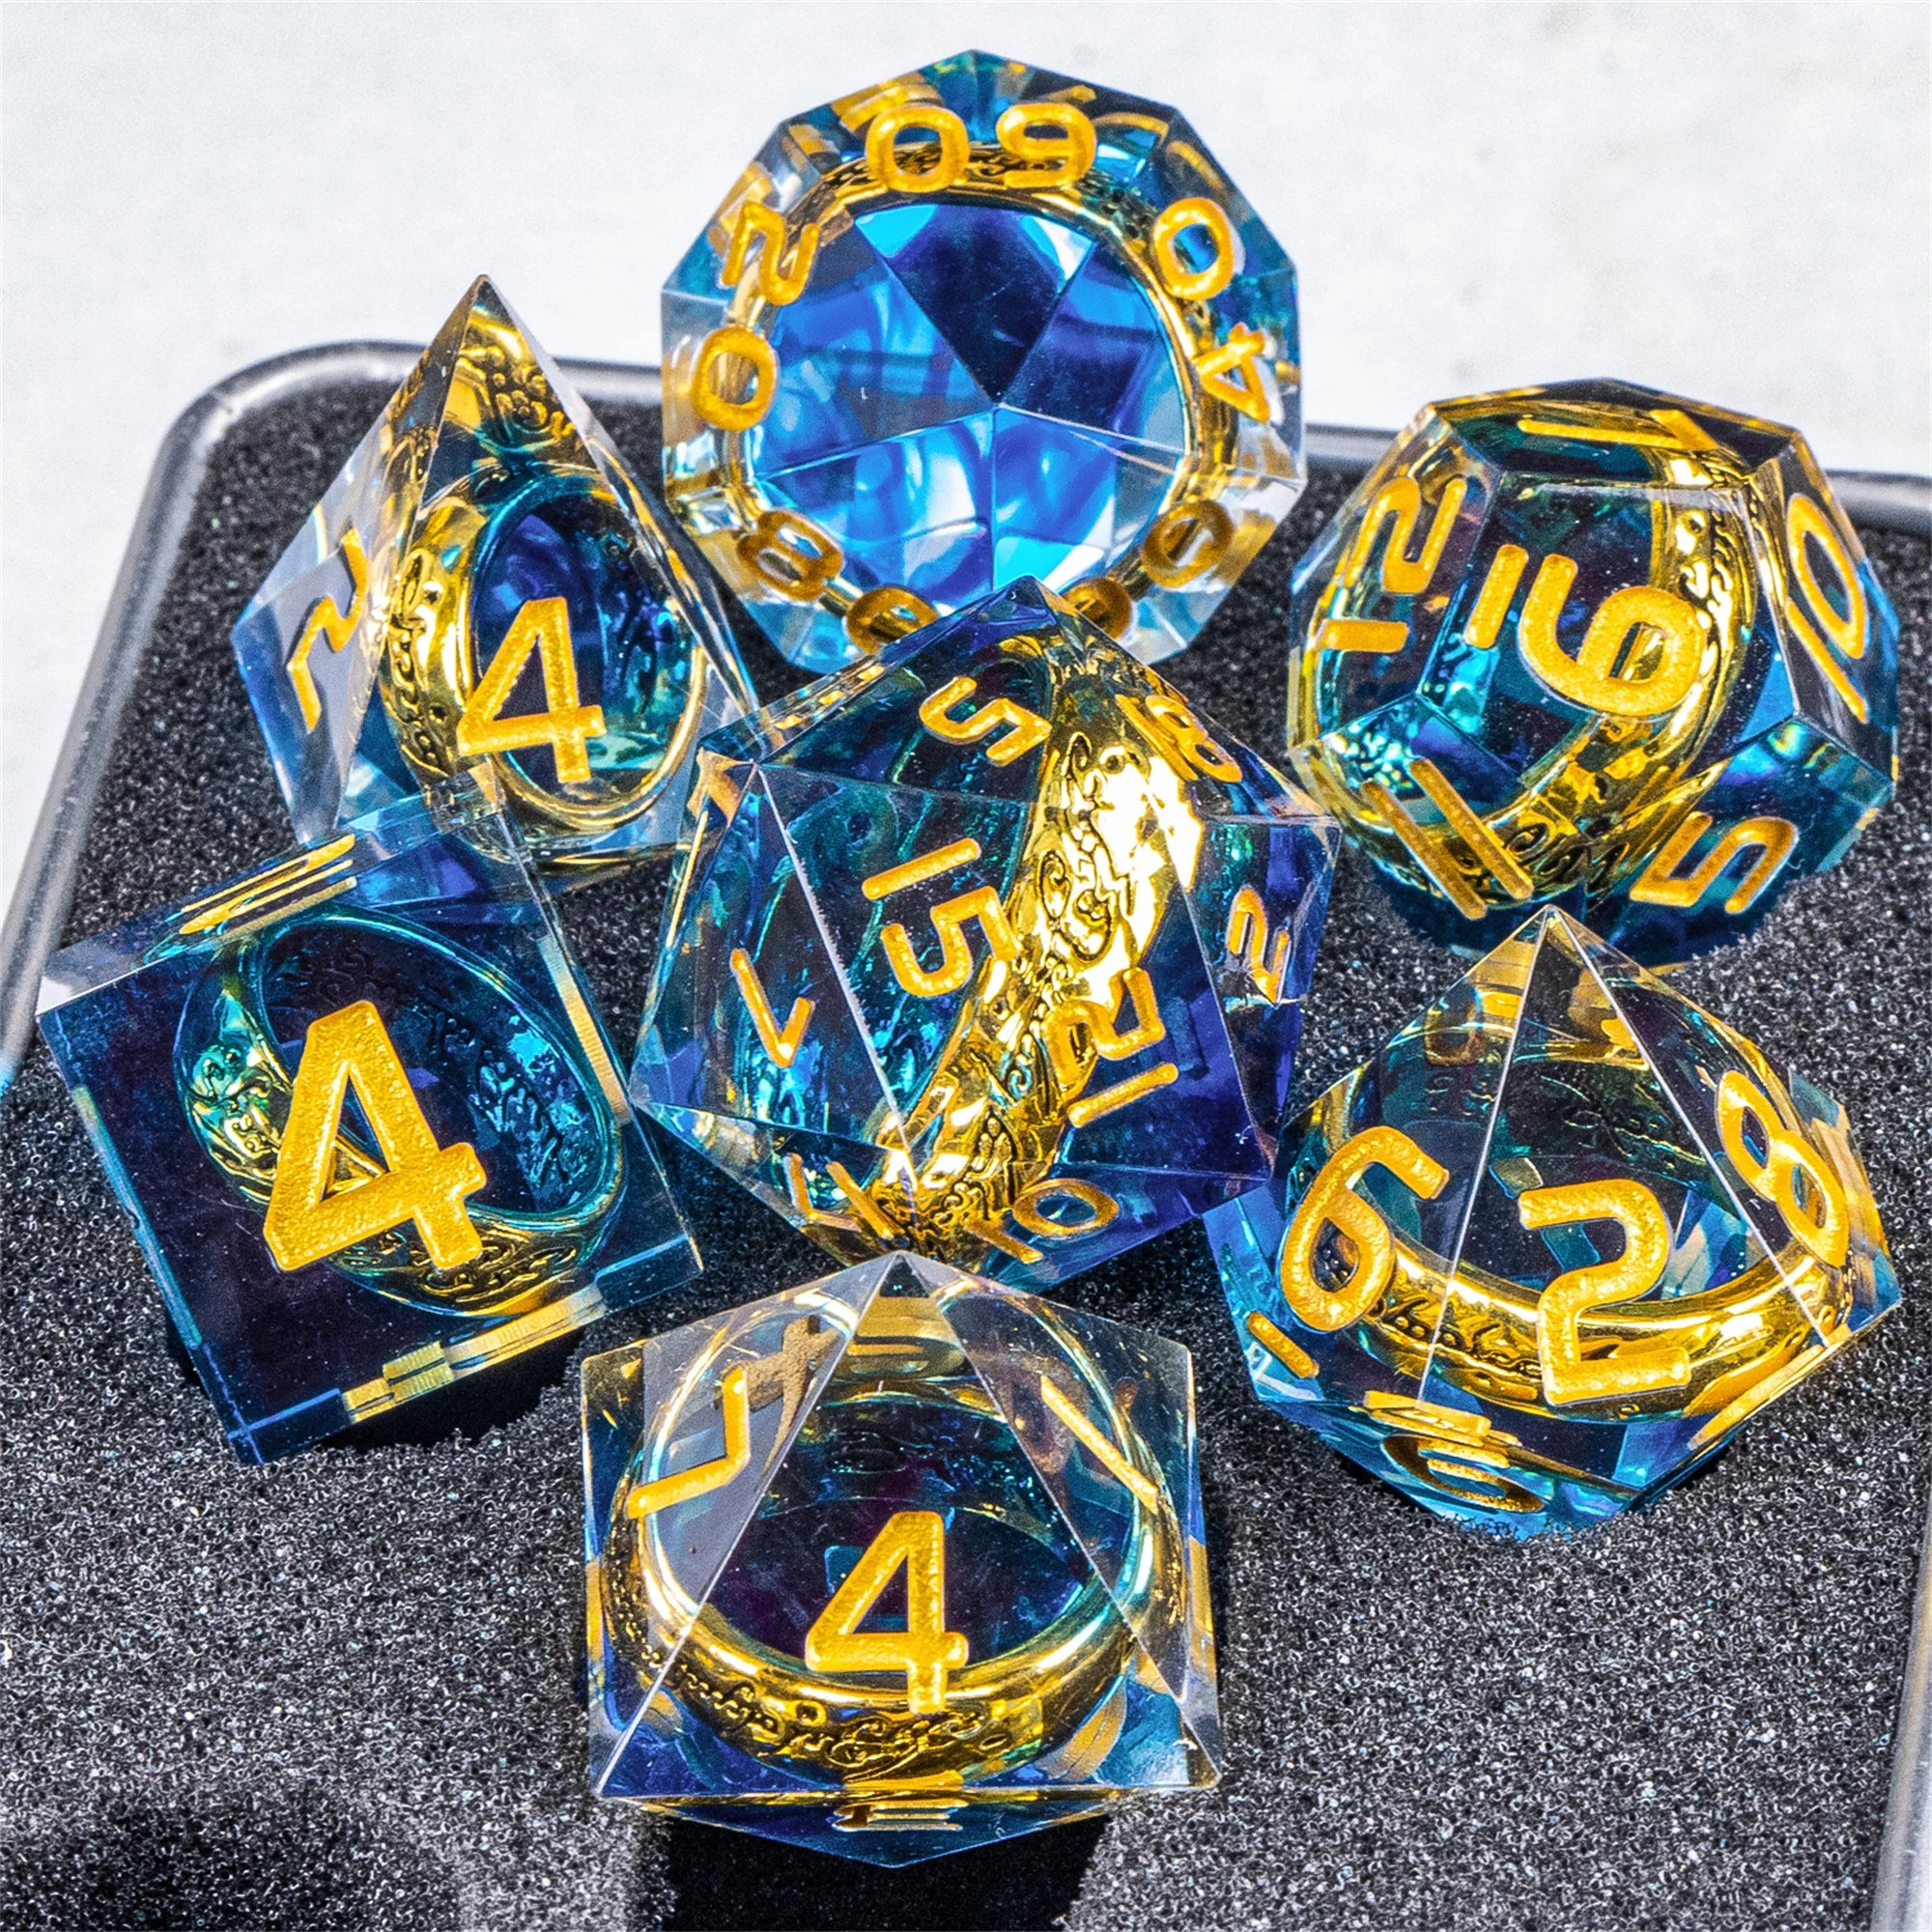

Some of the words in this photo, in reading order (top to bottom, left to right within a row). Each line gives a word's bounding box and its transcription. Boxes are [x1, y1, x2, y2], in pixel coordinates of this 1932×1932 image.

[1316, 476, 1468, 653] 12
[1785, 493, 1869, 724] 10
[456, 596, 608, 784] 4
[918, 676, 1052, 768] 5
[1113, 694, 1243, 784] 18
[862, 837, 1020, 999] 15
[1629, 810, 1800, 915] 5
[263, 999, 487, 1272] 4
[1039, 966, 1179, 1129] 12
[1715, 1069, 1848, 1268] 8
[1518, 1178, 1692, 1407] 2
[804, 1510, 971, 1716] 4
